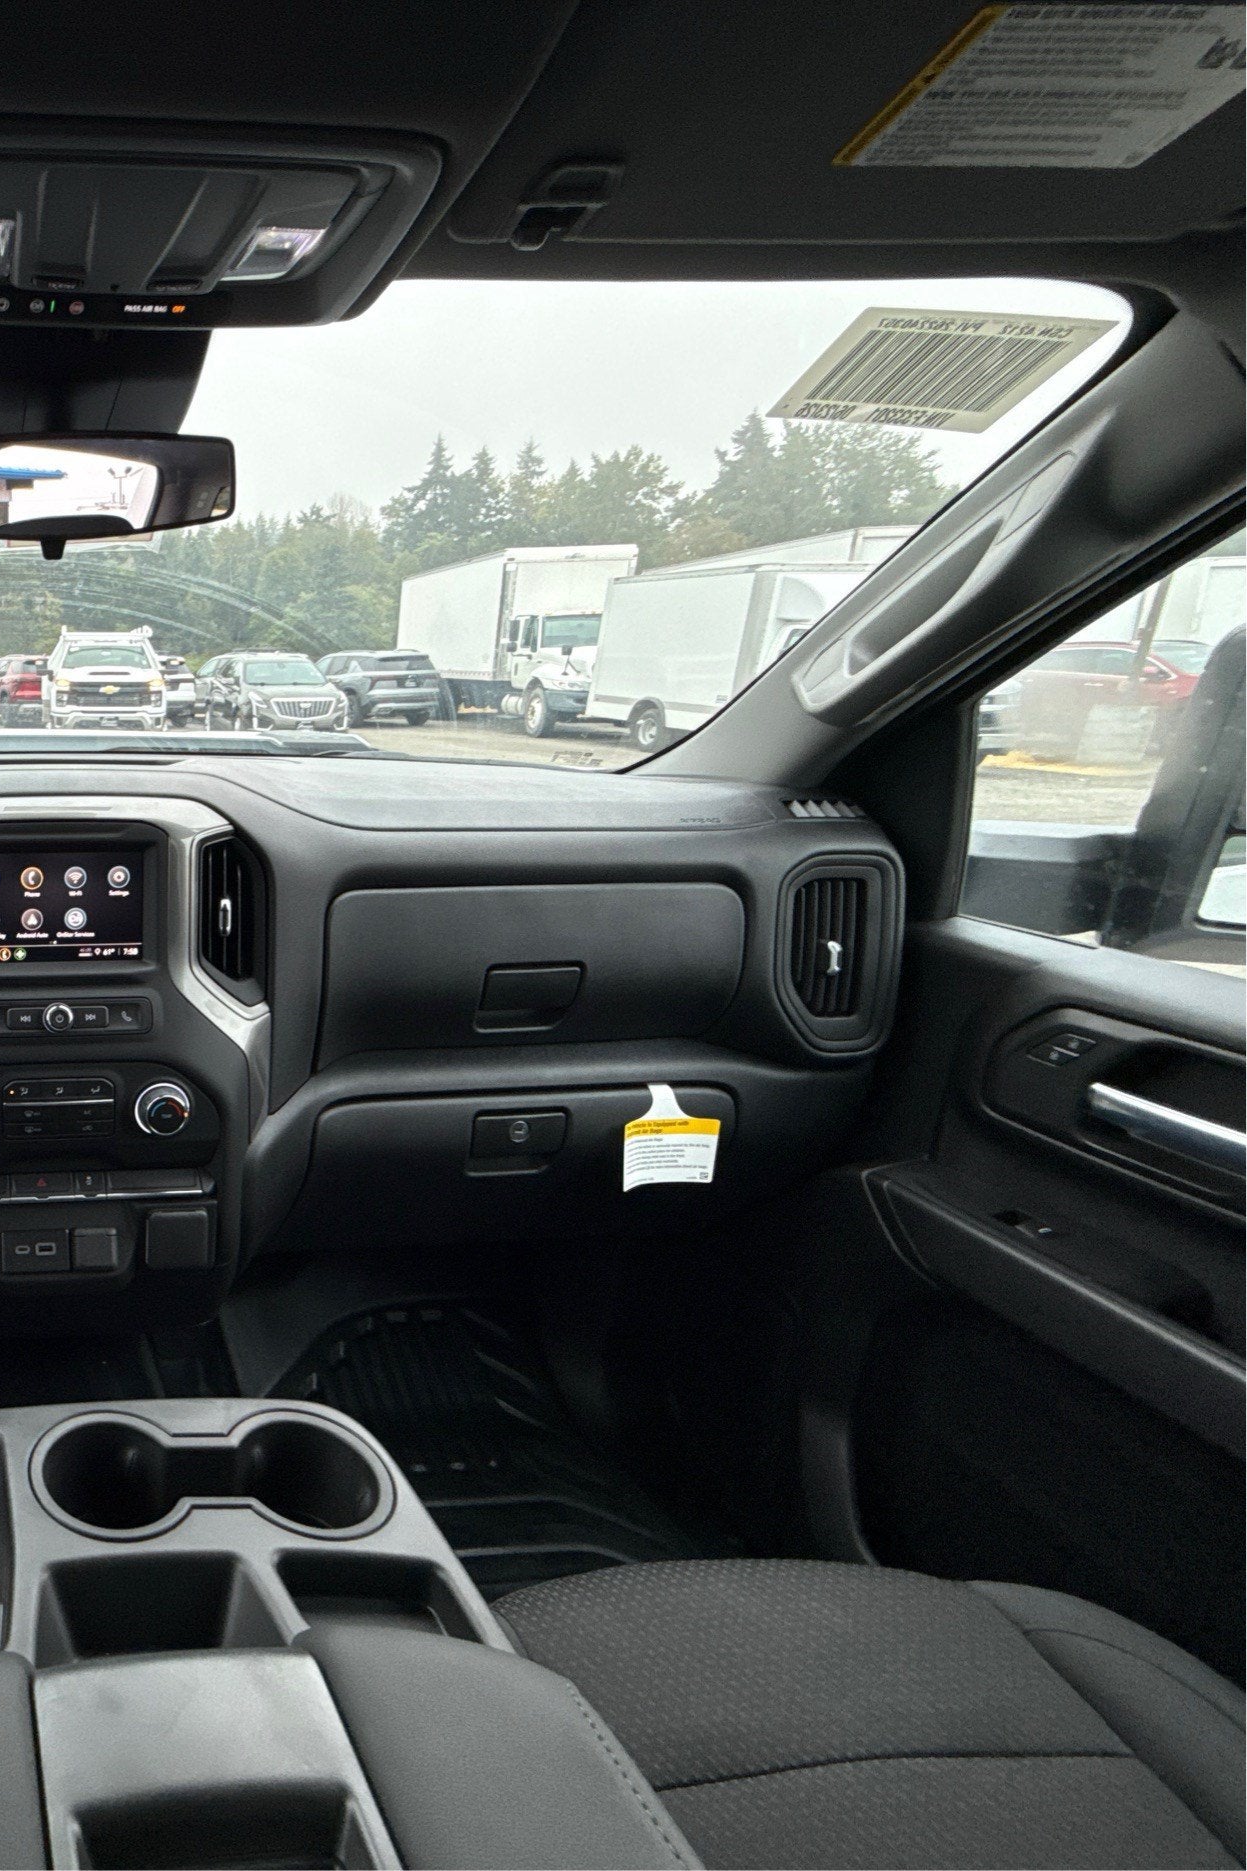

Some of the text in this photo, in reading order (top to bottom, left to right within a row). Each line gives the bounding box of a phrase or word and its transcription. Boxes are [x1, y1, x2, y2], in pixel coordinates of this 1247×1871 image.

[123, 304, 186, 313] PASS AIR BAG OFF
[108, 890, 130, 898] Settings
